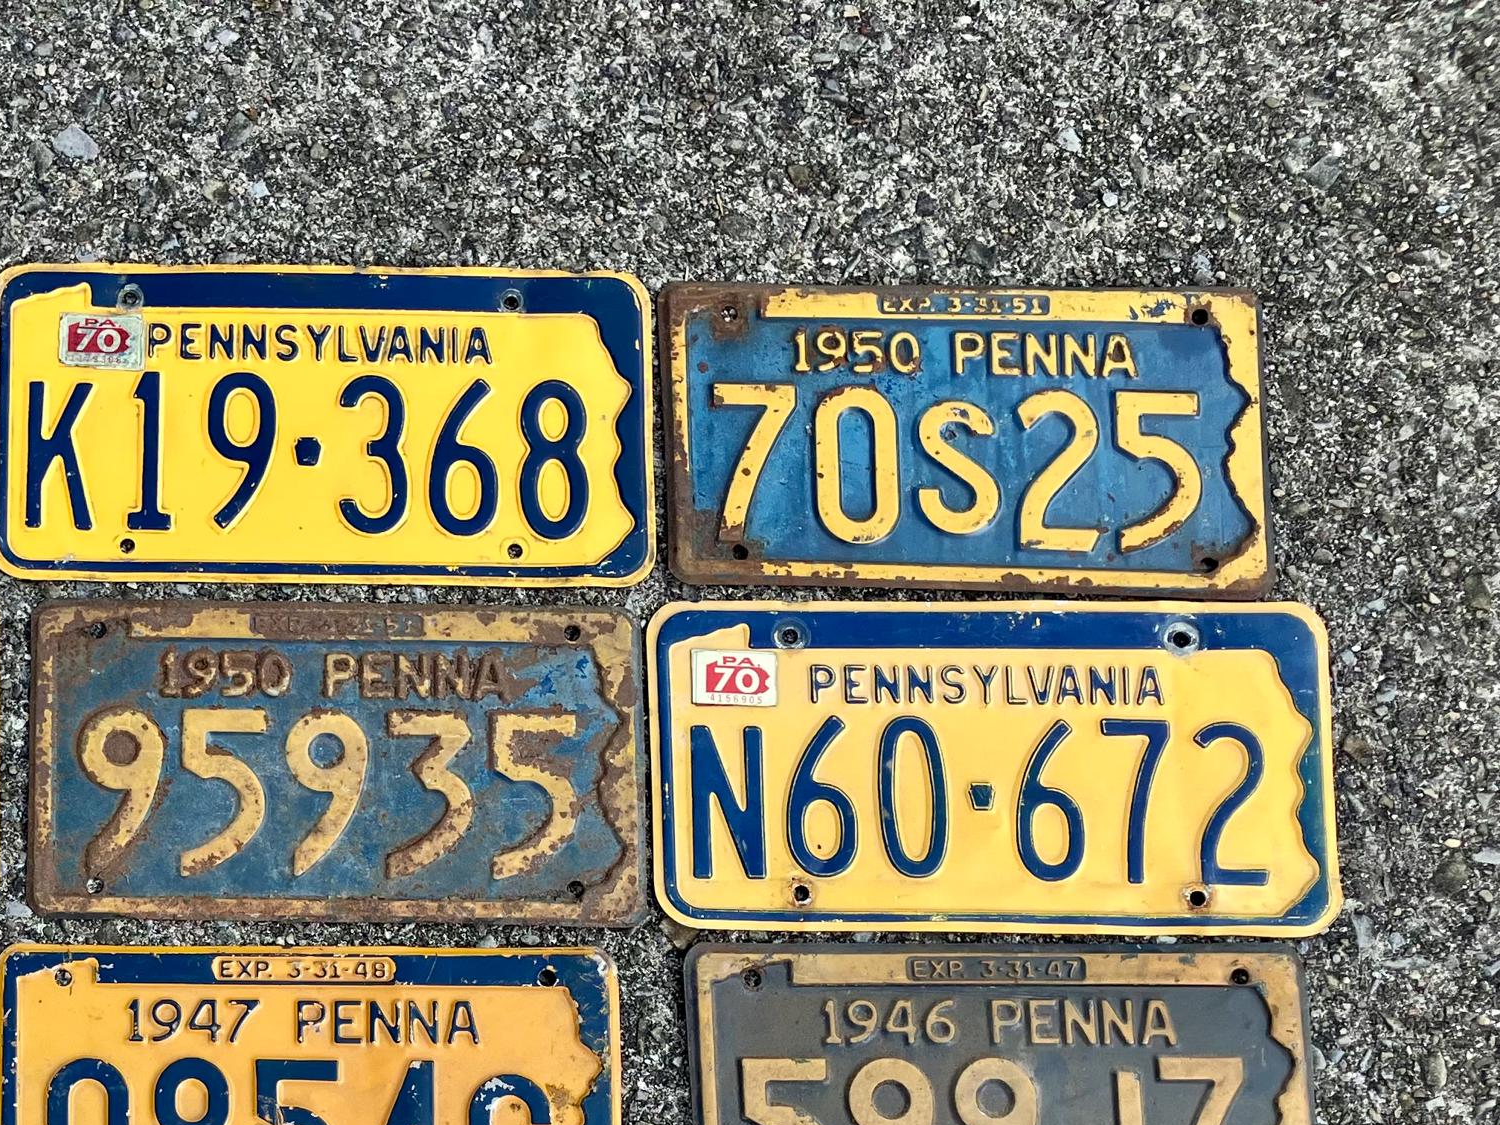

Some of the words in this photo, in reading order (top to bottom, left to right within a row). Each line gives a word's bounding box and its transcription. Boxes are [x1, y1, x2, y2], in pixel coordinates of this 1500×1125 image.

[947, 298, 1043, 313] 3-31-51
[76, 328, 121, 353] 70
[148, 323, 493, 364] PENNSYLVANIA
[795, 330, 919, 374] 1950
[955, 331, 1138, 378] PENNA
[713, 383, 1202, 553] 70S25
[160, 647, 291, 698] 1950
[323, 652, 504, 701] PENNA
[714, 668, 760, 694] 70
[810, 664, 1165, 706] PENNSYLVANIA
[79, 708, 577, 880] 95935
[220, 961, 272, 978] EXP.
[286, 961, 386, 979] 3-31-48
[979, 960, 1078, 978] 3-31-47
[128, 999, 260, 1042] 1947
[298, 1000, 479, 1045] PENNA
[823, 1000, 955, 1044] 1946
[991, 1000, 1178, 1045] PENNA
